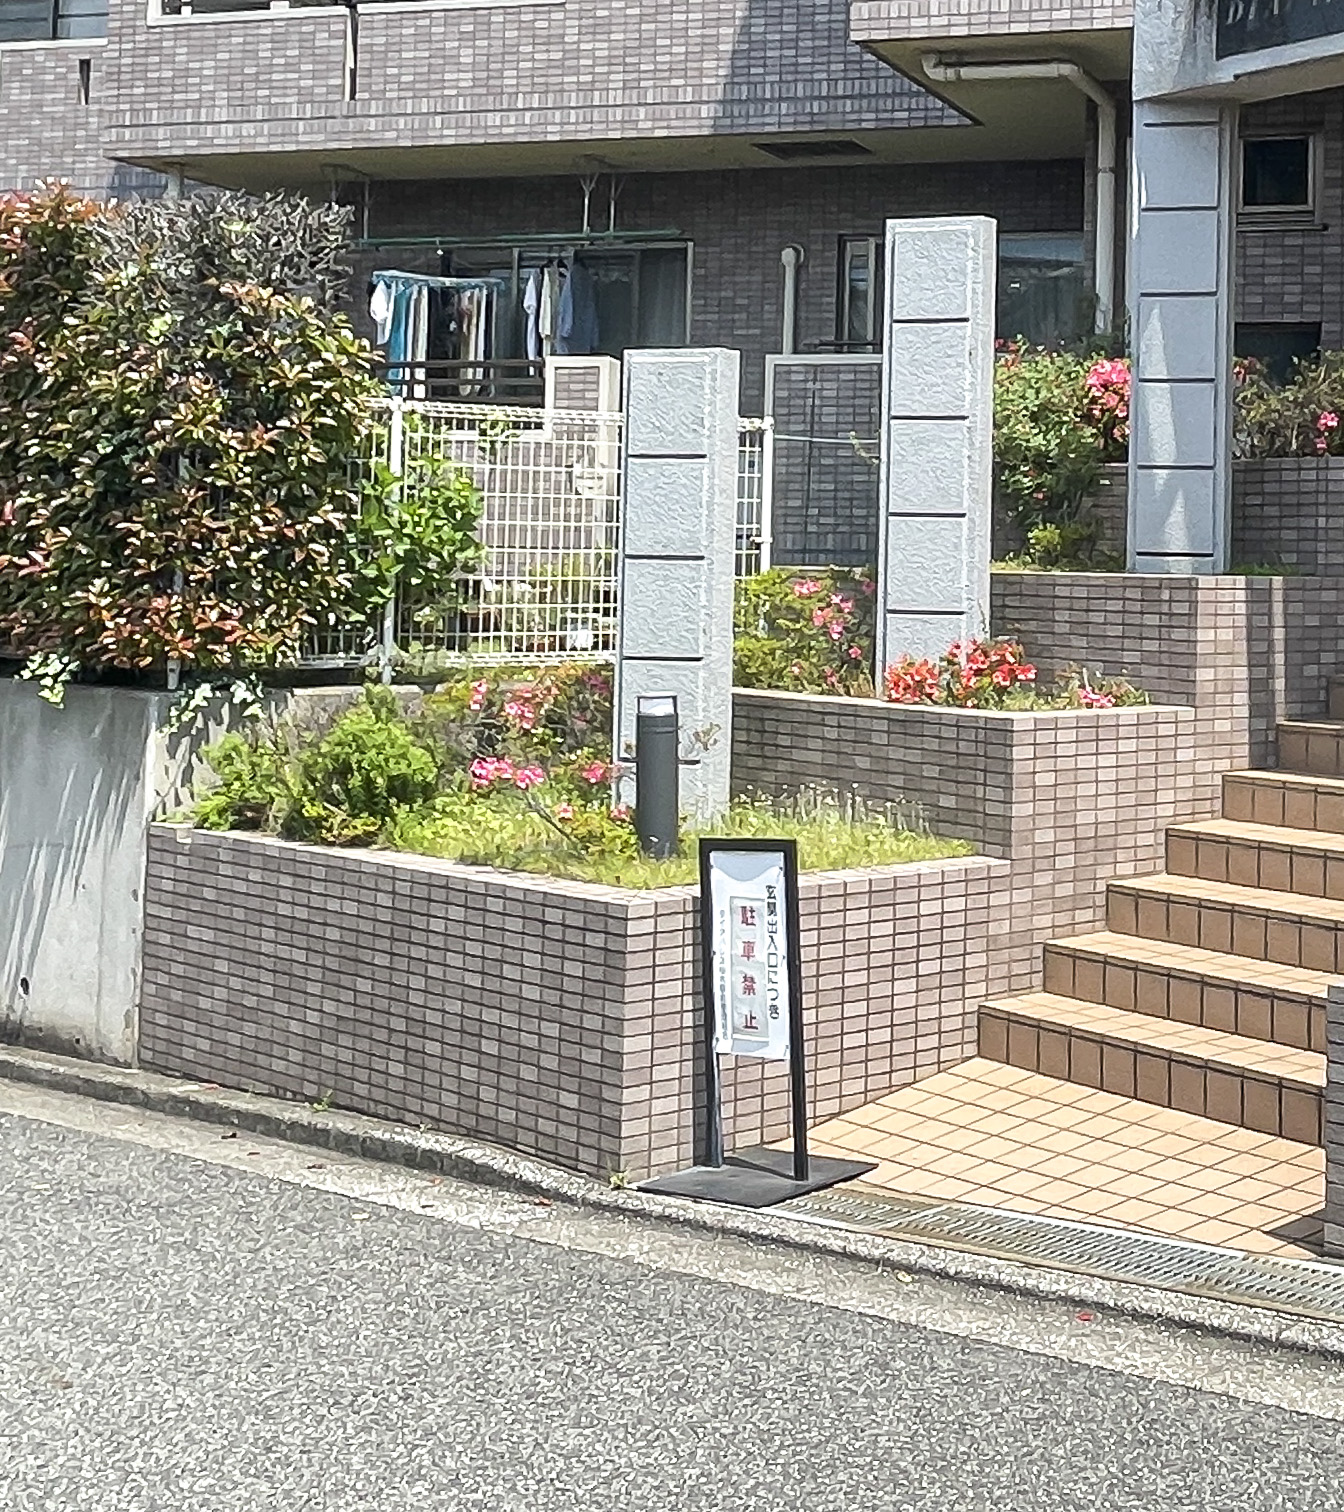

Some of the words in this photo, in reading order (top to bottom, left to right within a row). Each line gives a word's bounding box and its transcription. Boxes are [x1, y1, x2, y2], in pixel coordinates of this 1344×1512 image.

[740, 905, 759, 1030] 駐車禁止
[765, 884, 780, 1020] 玄関出入口につき
